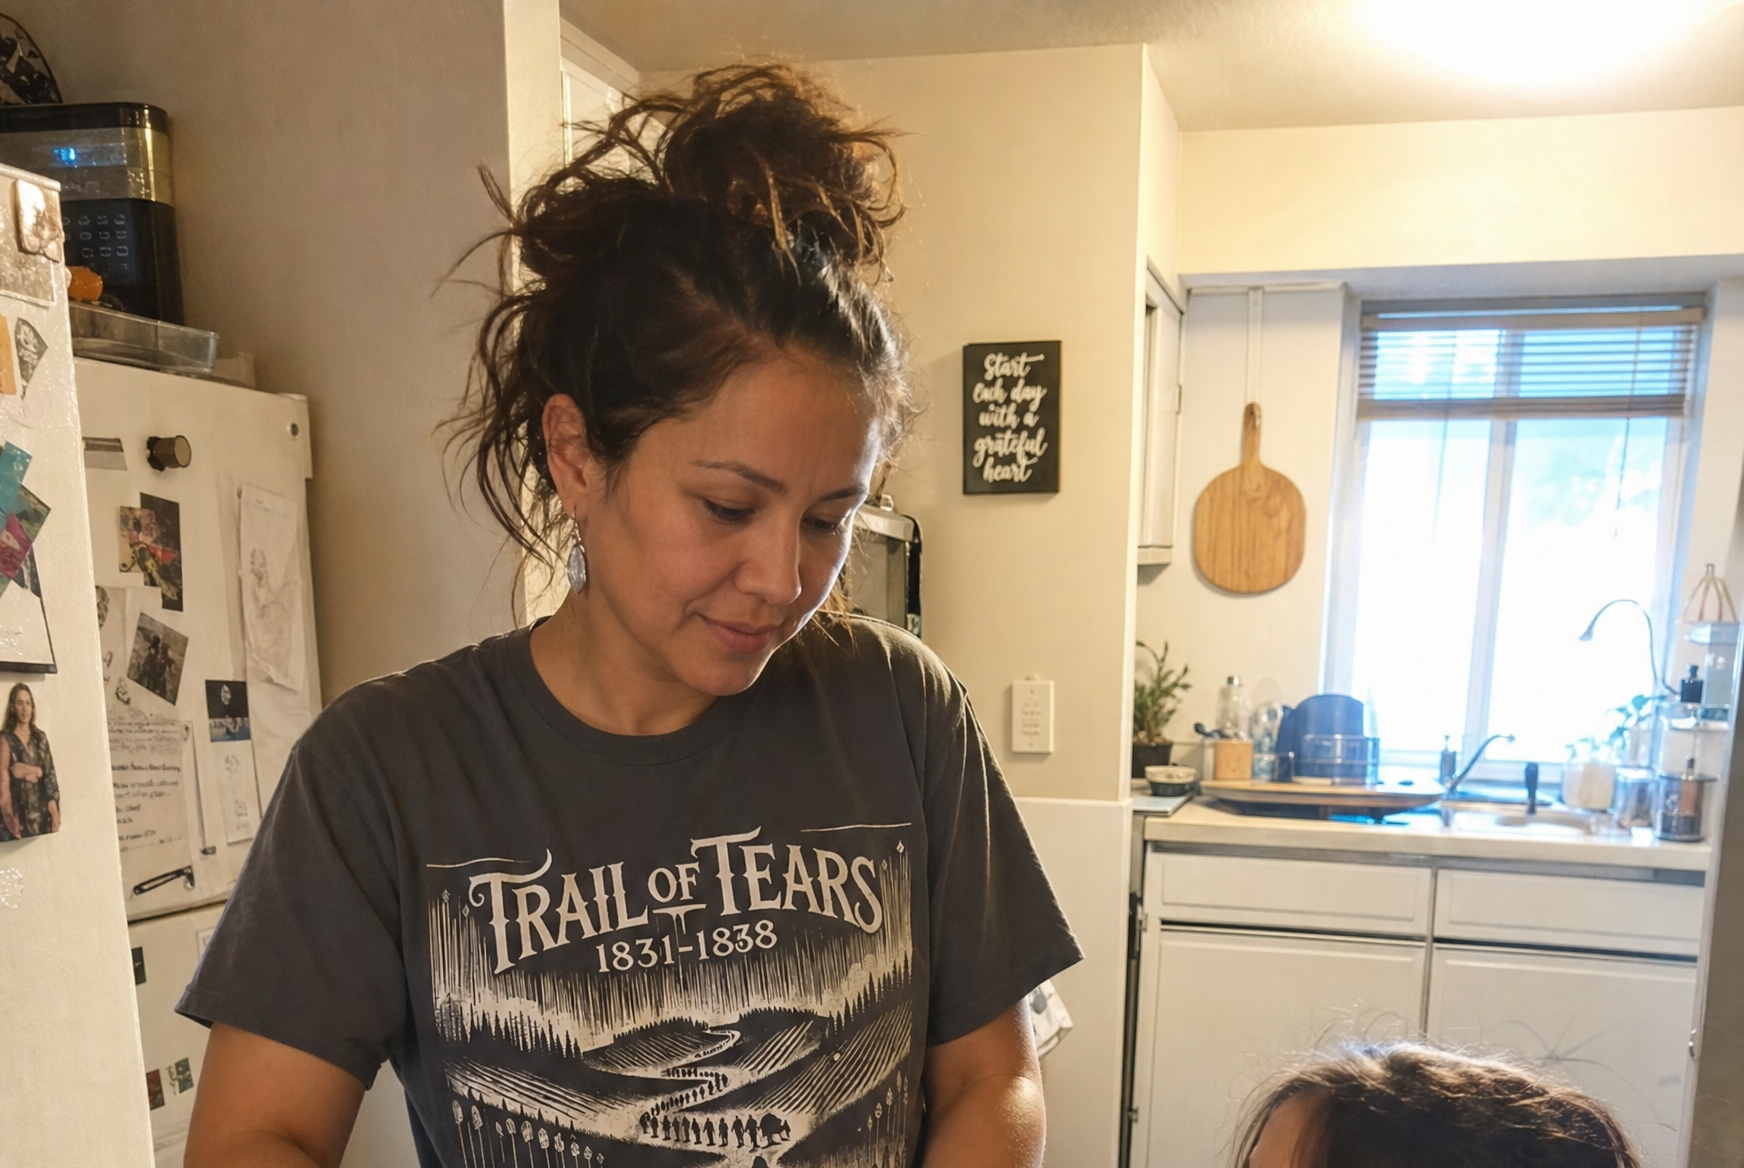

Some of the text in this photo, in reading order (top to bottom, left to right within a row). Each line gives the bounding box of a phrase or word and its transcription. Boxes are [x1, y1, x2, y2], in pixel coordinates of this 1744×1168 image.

[984, 352, 1045, 381] Start
[1010, 378, 1047, 412] day
[979, 402, 1039, 429] with a
[972, 427, 1048, 468] grateful
[983, 456, 1038, 483] heart
[469, 826, 883, 975] TRAIL OF TEARS
[595, 919, 778, 973] 1831-1838
